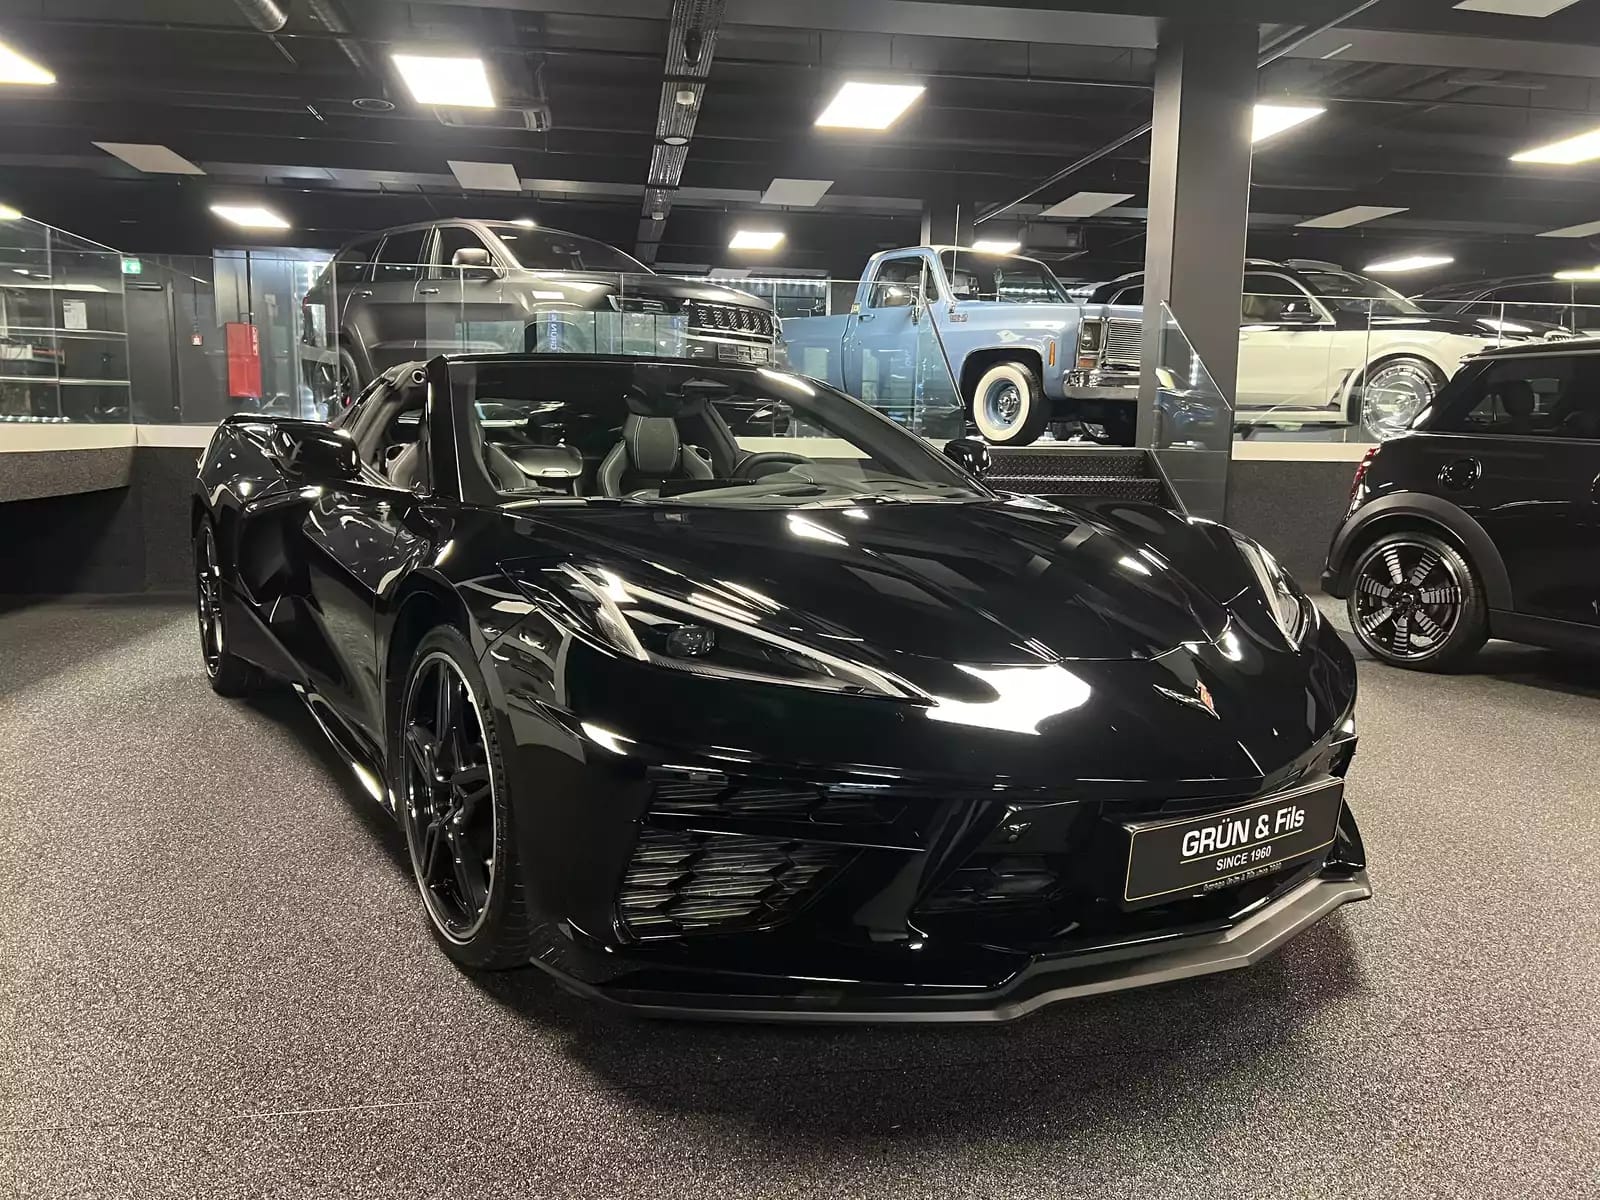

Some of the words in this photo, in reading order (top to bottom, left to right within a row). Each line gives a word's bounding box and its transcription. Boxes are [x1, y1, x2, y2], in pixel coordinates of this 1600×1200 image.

[1182, 817, 1250, 857] GRÜN
[1254, 814, 1270, 839] &
[1274, 805, 1305, 834] Fils
[1216, 852, 1249, 871] SINCE
[1250, 845, 1272, 862] 1960
